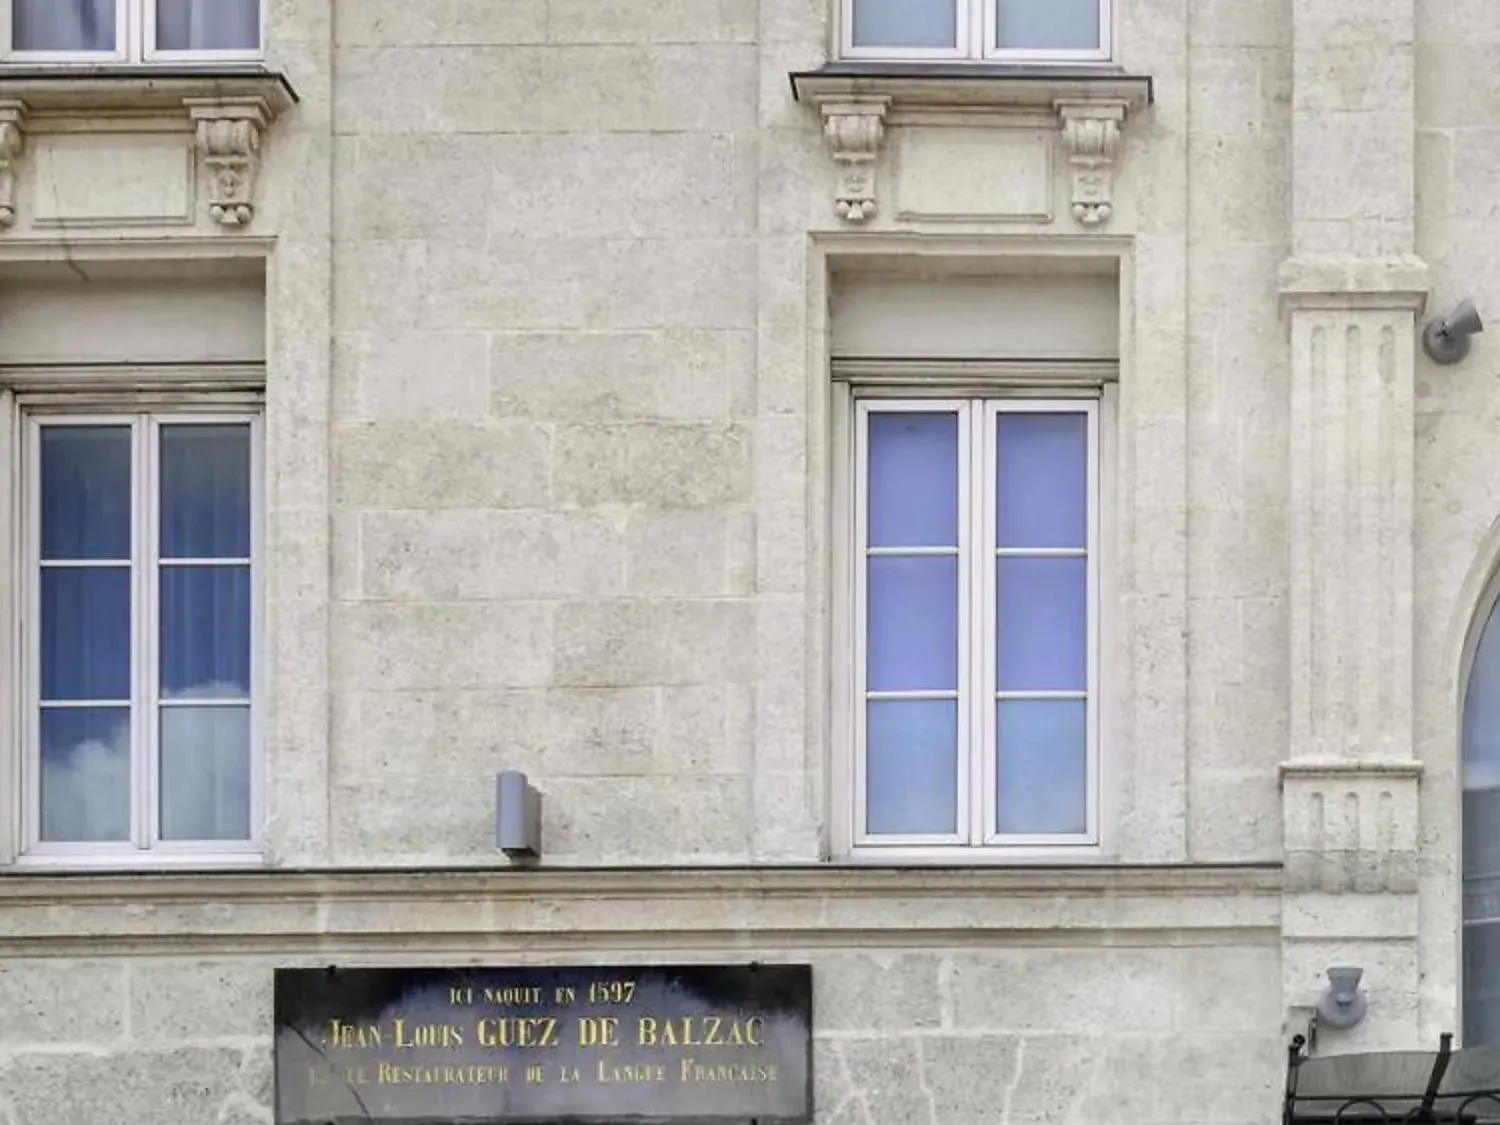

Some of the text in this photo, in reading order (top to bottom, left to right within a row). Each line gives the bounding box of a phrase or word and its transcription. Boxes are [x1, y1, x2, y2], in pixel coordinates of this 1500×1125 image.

[450, 981, 636, 1006] ICI NAQUIT EN 1597
[477, 1017, 558, 1047] GUEZ
[579, 1017, 619, 1046] DE
[638, 1016, 765, 1046] BALZAC
